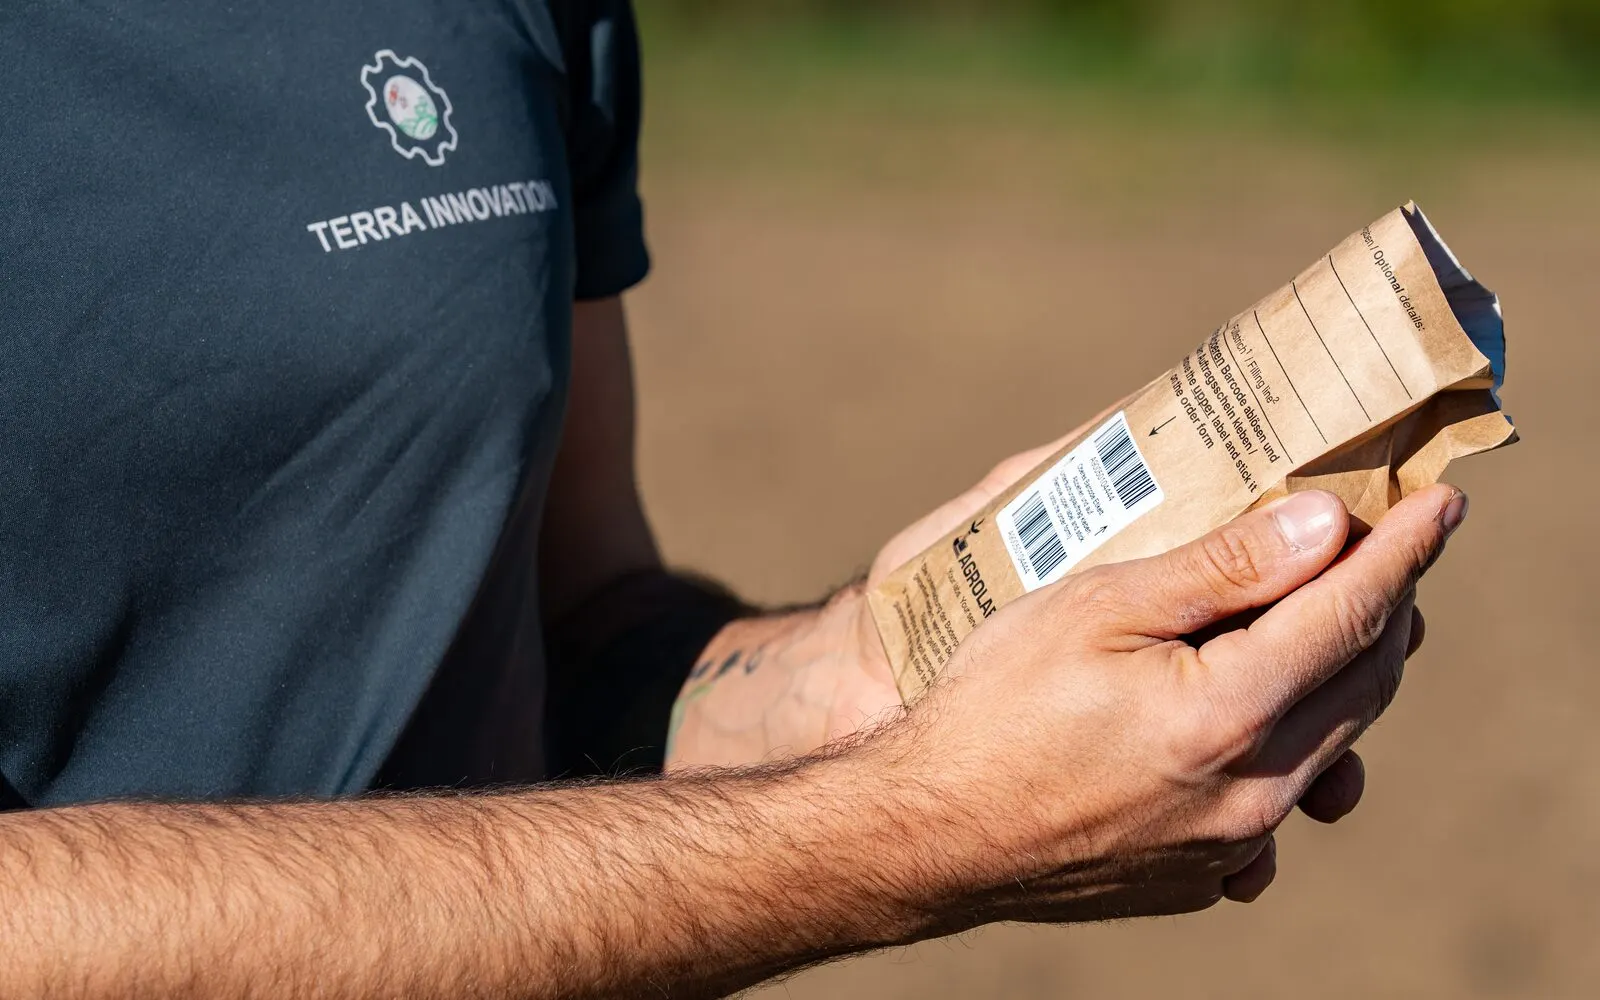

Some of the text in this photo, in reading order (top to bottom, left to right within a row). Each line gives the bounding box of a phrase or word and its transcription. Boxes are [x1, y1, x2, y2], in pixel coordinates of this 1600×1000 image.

[307, 179, 557, 252] TERRA INNOVATION
[1373, 250, 1405, 294] Optional
[1398, 295, 1425, 332] details:
[1172, 380, 1184, 397] the
[1180, 397, 1201, 424] order
[1196, 422, 1214, 449] form
[1198, 353, 1236, 420] Auftragsschein
[1232, 417, 1253, 451] kleben
[1220, 364, 1247, 407] Barcode
[1243, 406, 1267, 444] ablösen
[1263, 442, 1281, 464] und
[1247, 360, 1265, 390] Filling
[1185, 369, 1197, 386] the
[1192, 385, 1216, 418] upper
[1211, 414, 1231, 442] label
[1225, 440, 1241, 461] and
[1235, 459, 1252, 484] stick
[1247, 480, 1258, 493] it
